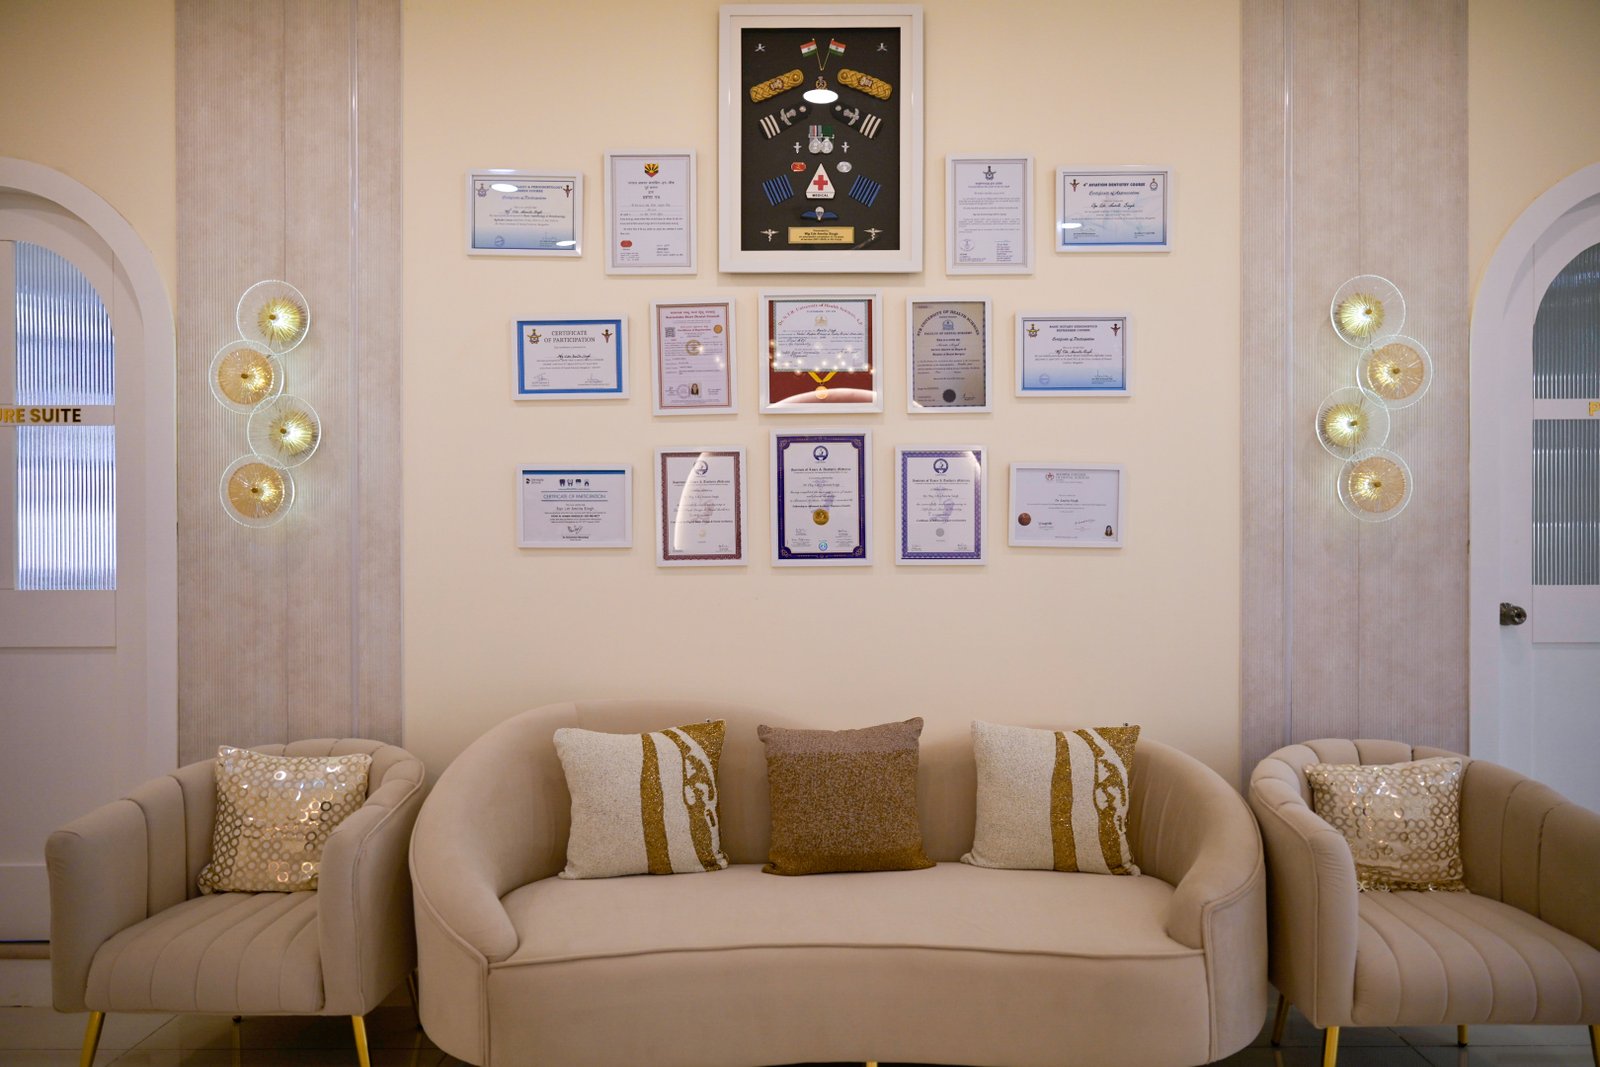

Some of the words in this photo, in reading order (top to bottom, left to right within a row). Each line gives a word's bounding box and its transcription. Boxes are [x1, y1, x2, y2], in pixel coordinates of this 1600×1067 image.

[921, 310, 942, 328] UNIVERSITY
[950, 310, 966, 318] HEALTH
[0, 408, 25, 423] RE
[30, 408, 81, 423] SUITE
